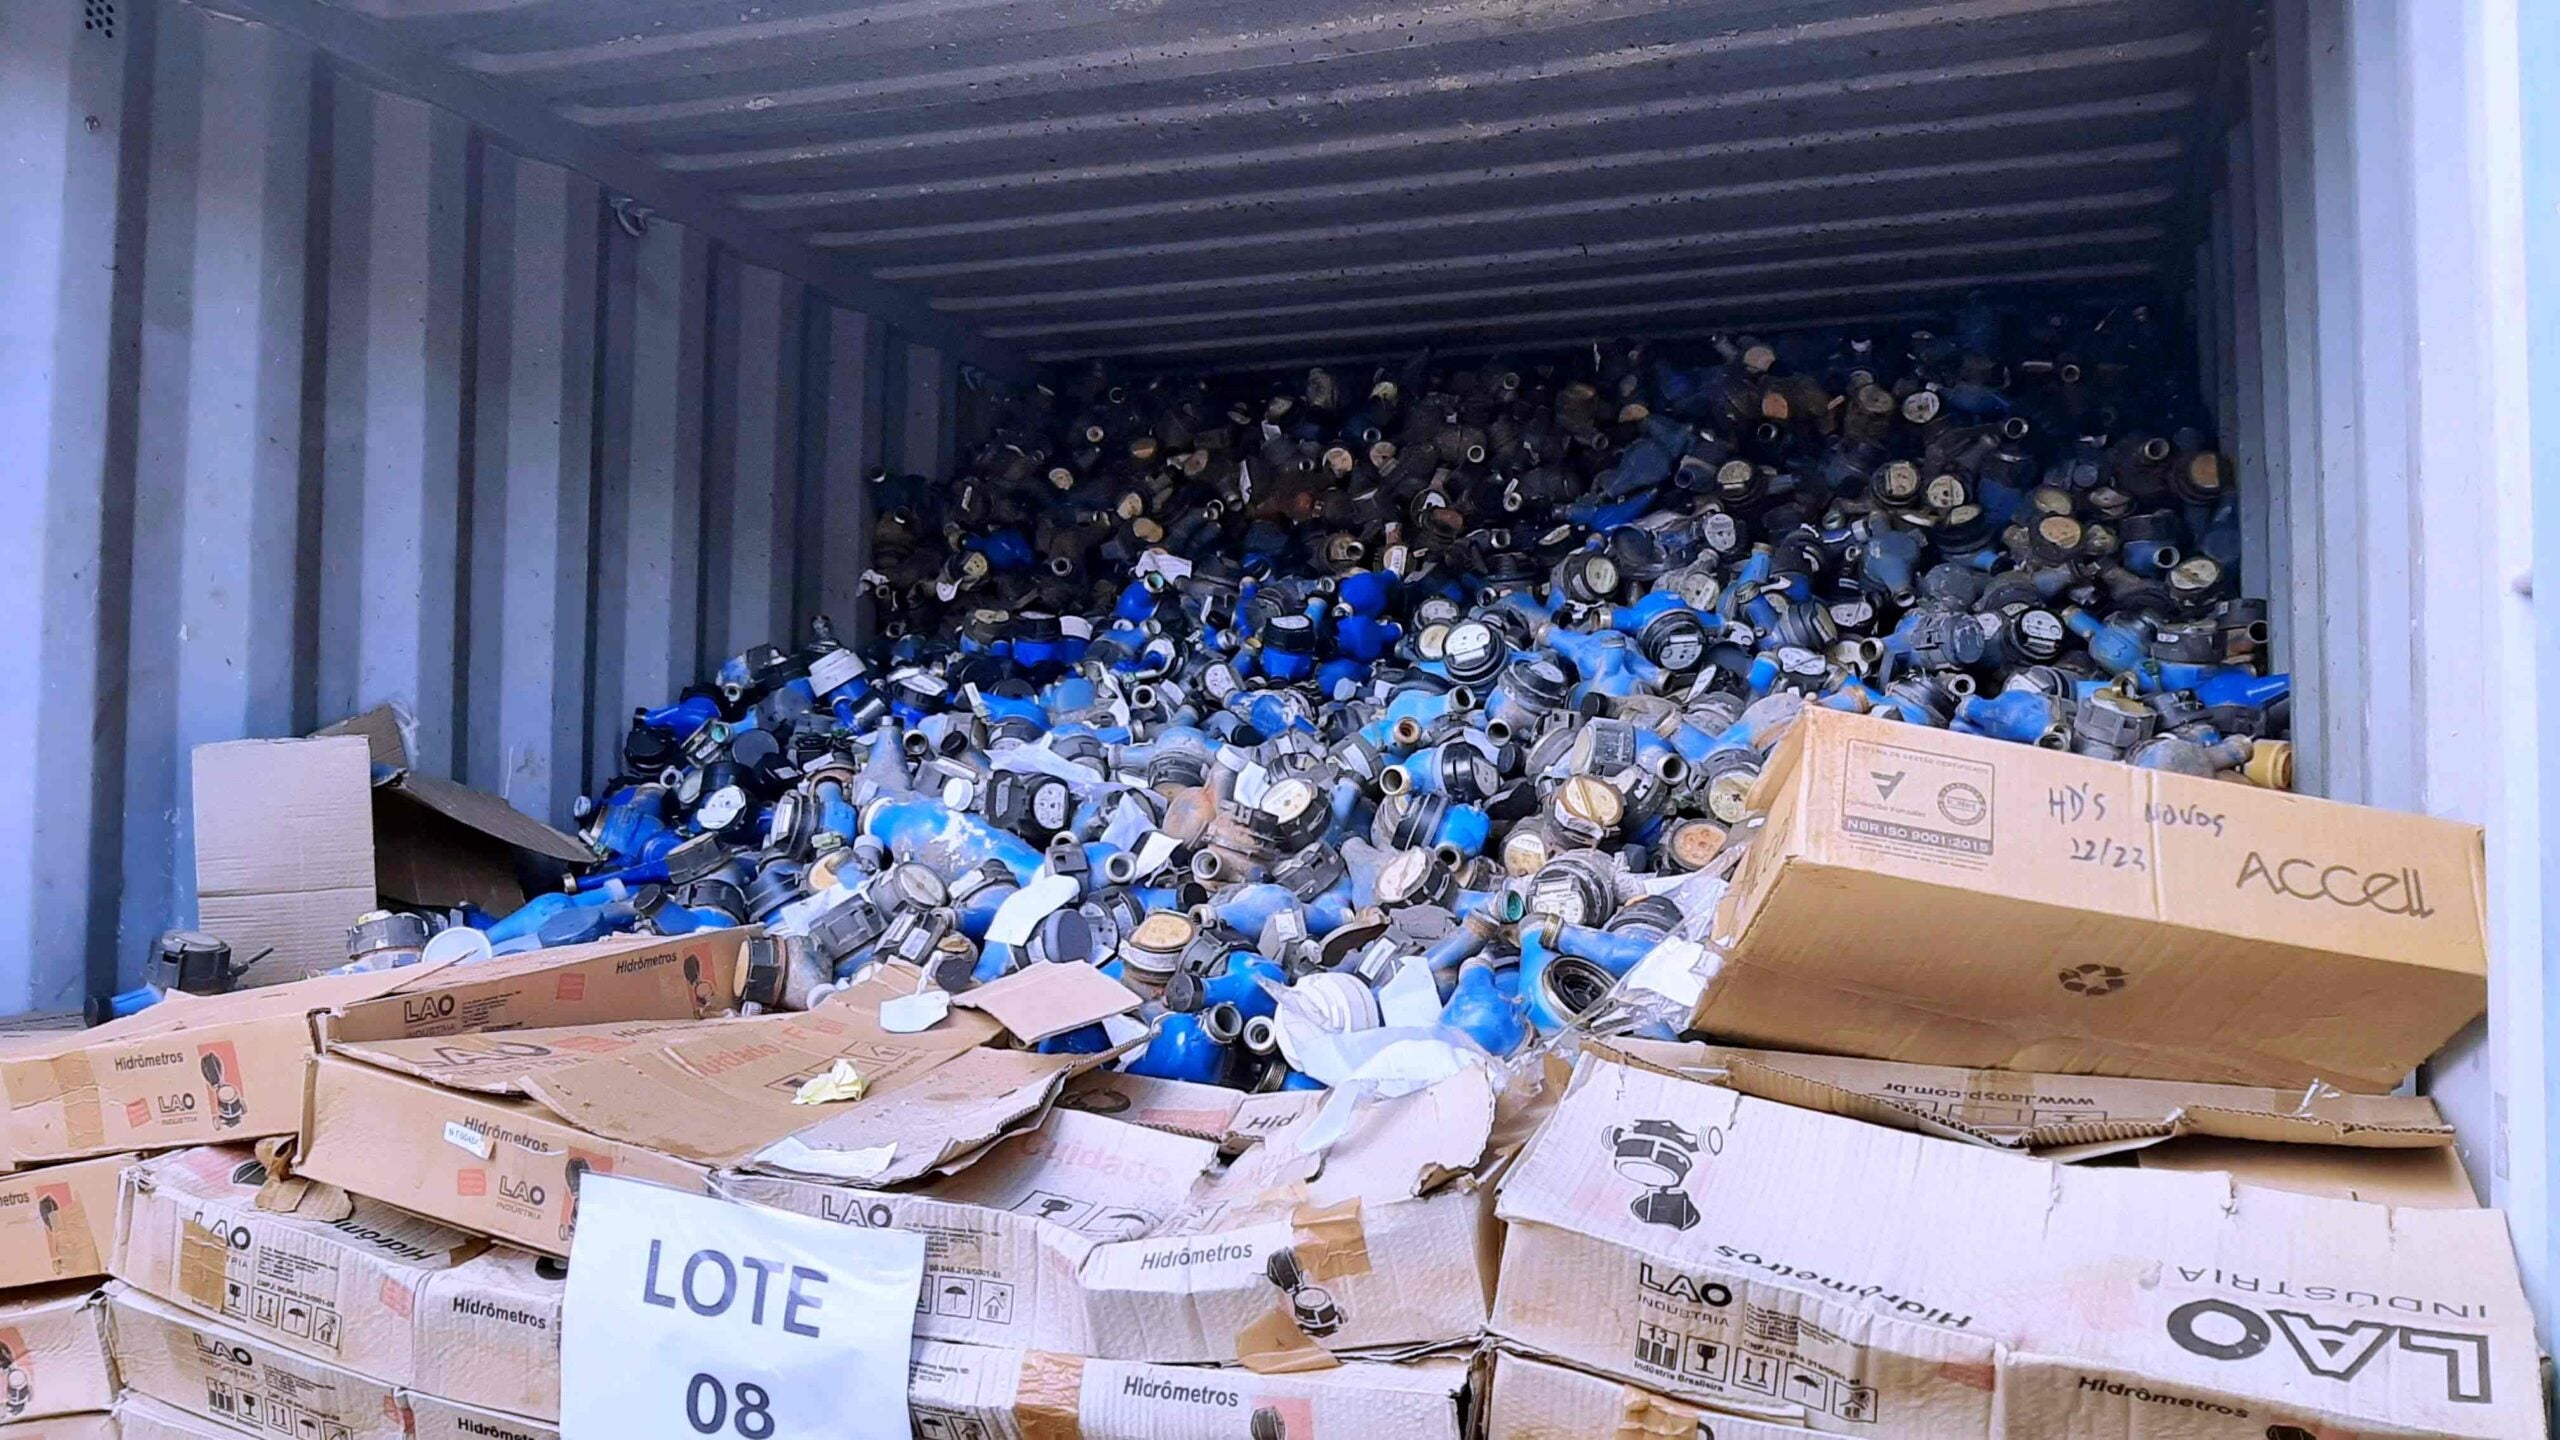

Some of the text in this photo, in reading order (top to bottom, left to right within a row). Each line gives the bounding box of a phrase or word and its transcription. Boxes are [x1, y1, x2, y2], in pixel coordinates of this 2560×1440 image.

[1848, 819, 1990, 851] NBR ISO 9001:2015
[616, 952, 677, 975] Hidrômetros
[404, 994, 455, 1024] LAO
[115, 1051, 184, 1071] Hidrômetros
[695, 1044, 781, 1077] uidado
[158, 1093, 195, 1113] LAO
[464, 1116, 549, 1152] Hidrômetros
[500, 1175, 545, 1206] LAO
[822, 1194, 893, 1228] LAO
[335, 1221, 437, 1261] Hidrôm
[1141, 1243, 1253, 1270] Hidrômetros
[643, 1239, 829, 1339] LOTE
[1640, 1262, 1733, 1307] LAO
[1713, 1245, 1973, 1328] Hidrômetros
[452, 1297, 547, 1330] Hidrômetros
[192, 1332, 253, 1366] LAO
[1649, 1327, 1668, 1343] 13
[2167, 1298, 2493, 1404] LAO
[1123, 1375, 1239, 1407] Hidrômetros
[1634, 1360, 1724, 1392] Indústria Brasileira
[686, 1373, 775, 1440] 08
[2077, 1376, 2249, 1419] Hidrômetros
